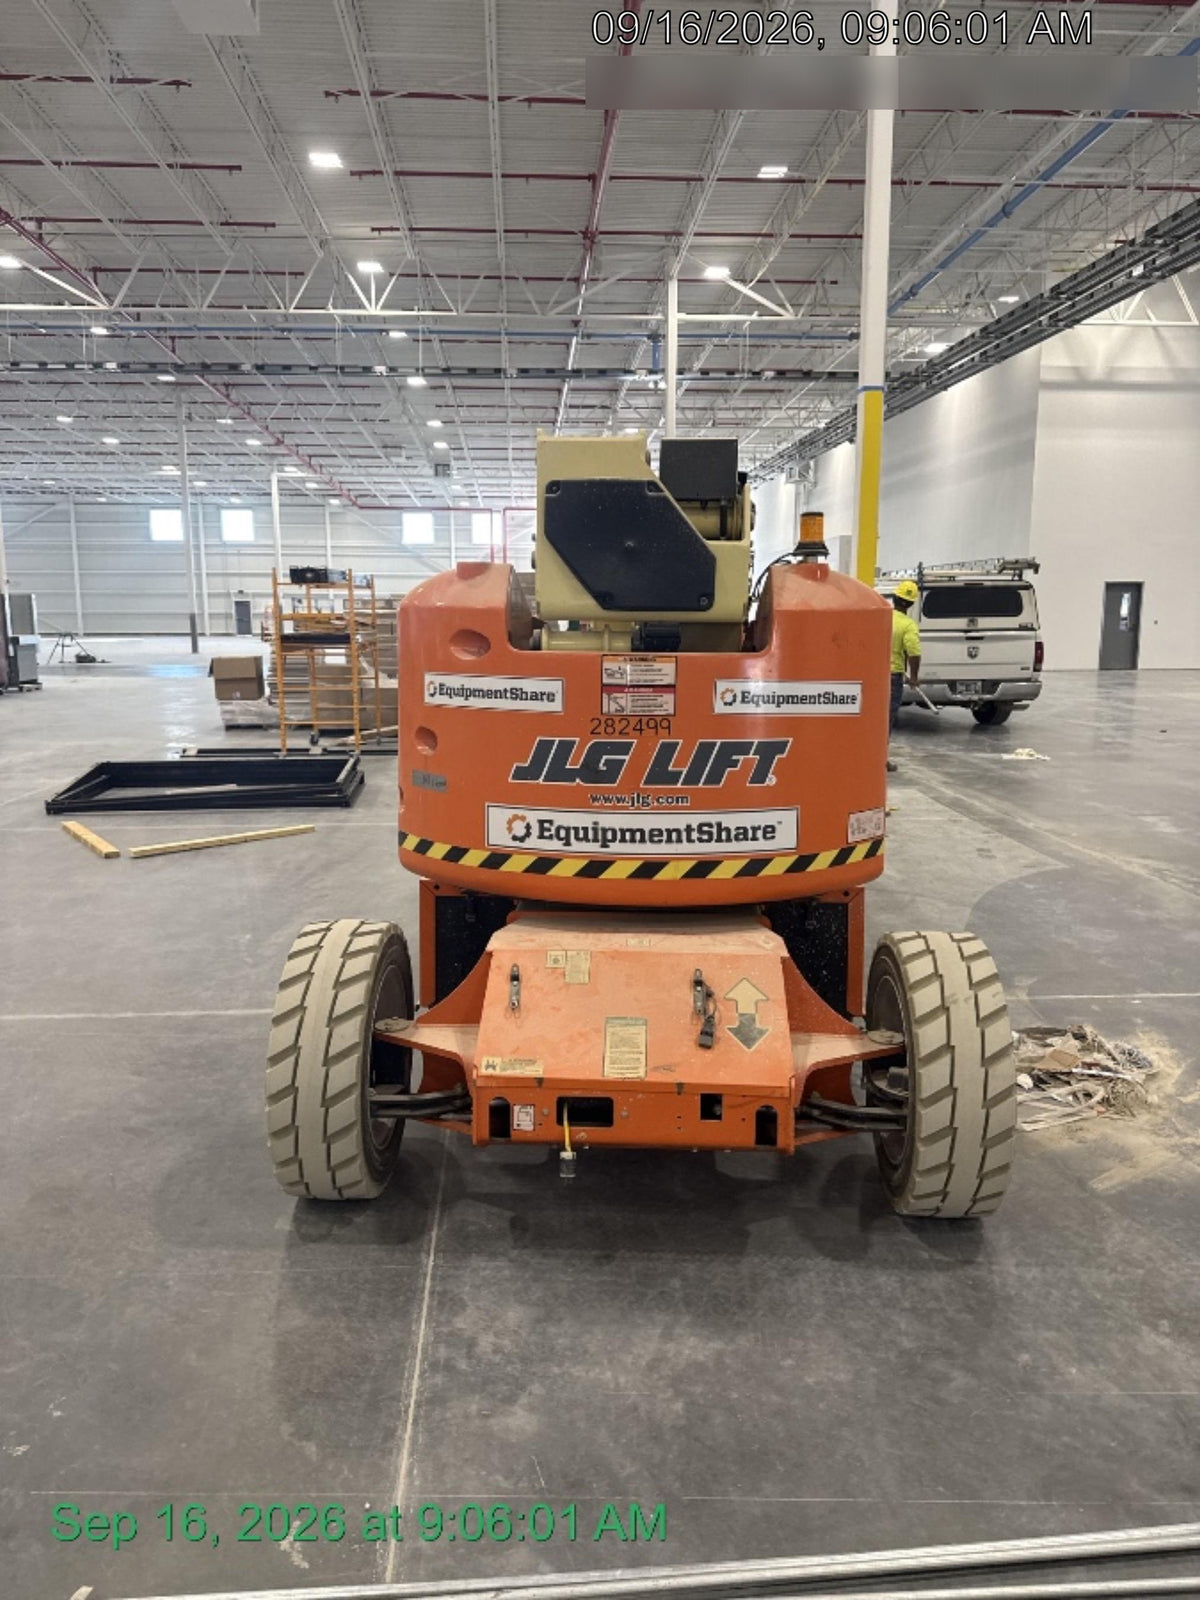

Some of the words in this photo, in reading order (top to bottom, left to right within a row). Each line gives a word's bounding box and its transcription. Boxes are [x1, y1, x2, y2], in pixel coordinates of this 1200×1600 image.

[438, 682, 557, 703] EquipmentShare
[740, 689, 858, 708] EquipmentShare
[589, 718, 672, 736] 282499
[509, 738, 636, 786] JLG
[589, 793, 690, 808] www.jlg.com
